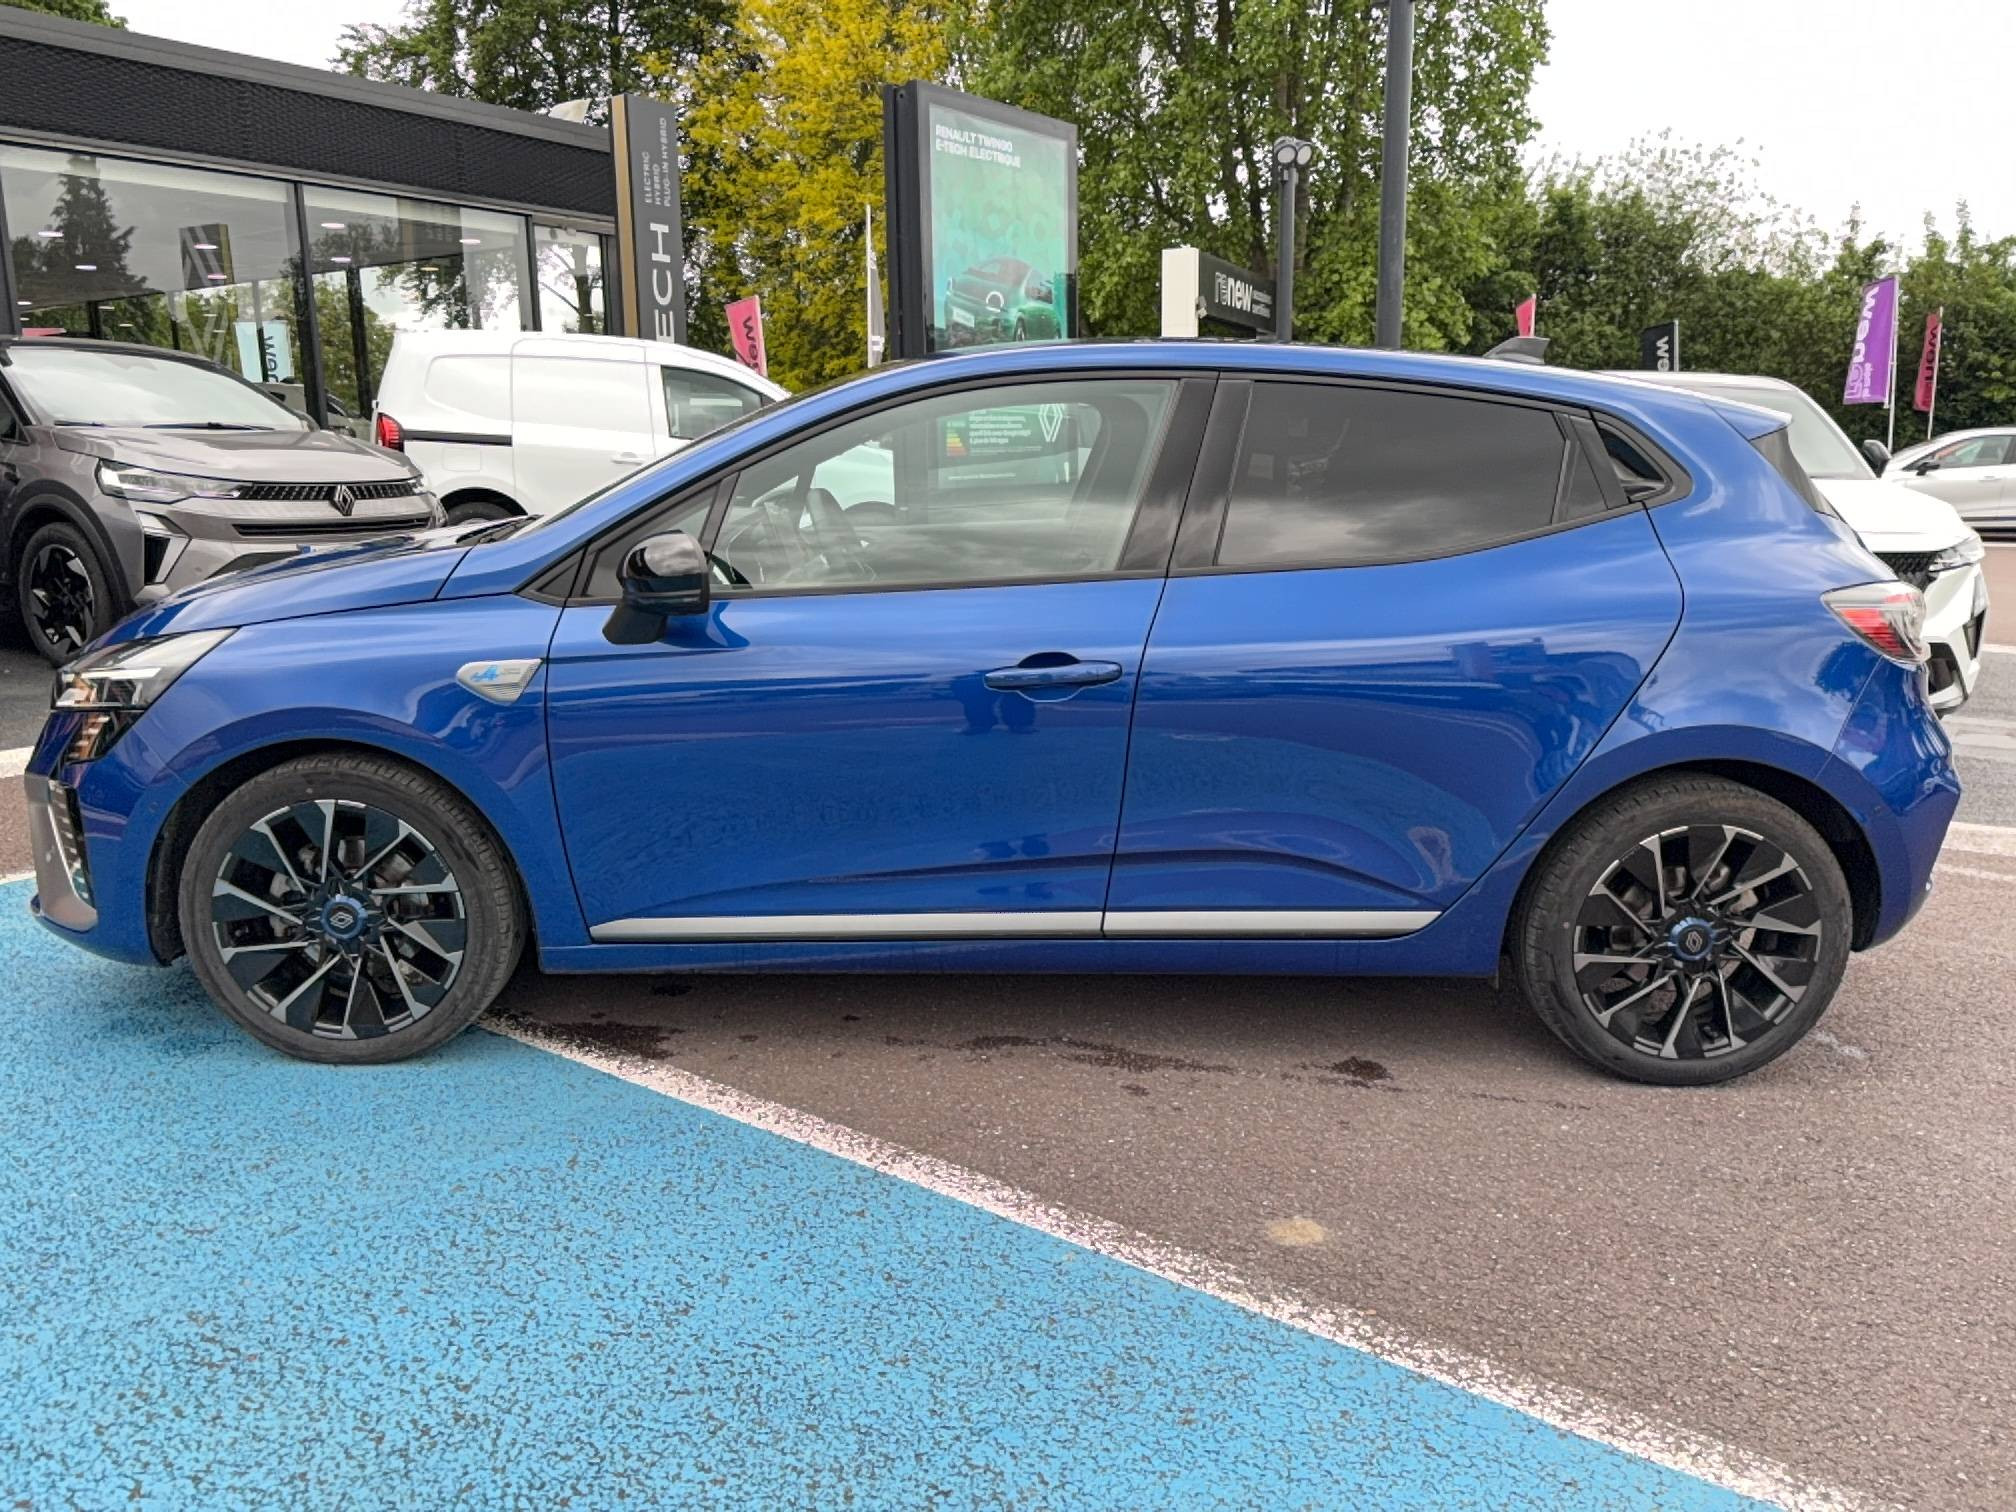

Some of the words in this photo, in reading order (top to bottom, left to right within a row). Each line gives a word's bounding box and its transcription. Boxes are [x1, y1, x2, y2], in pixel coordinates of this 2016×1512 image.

[659, 117, 669, 160] HYBRID
[641, 151, 653, 203] ELECTRIC
[652, 163, 661, 205] HYBRID
[662, 161, 671, 207] PLUG-IN
